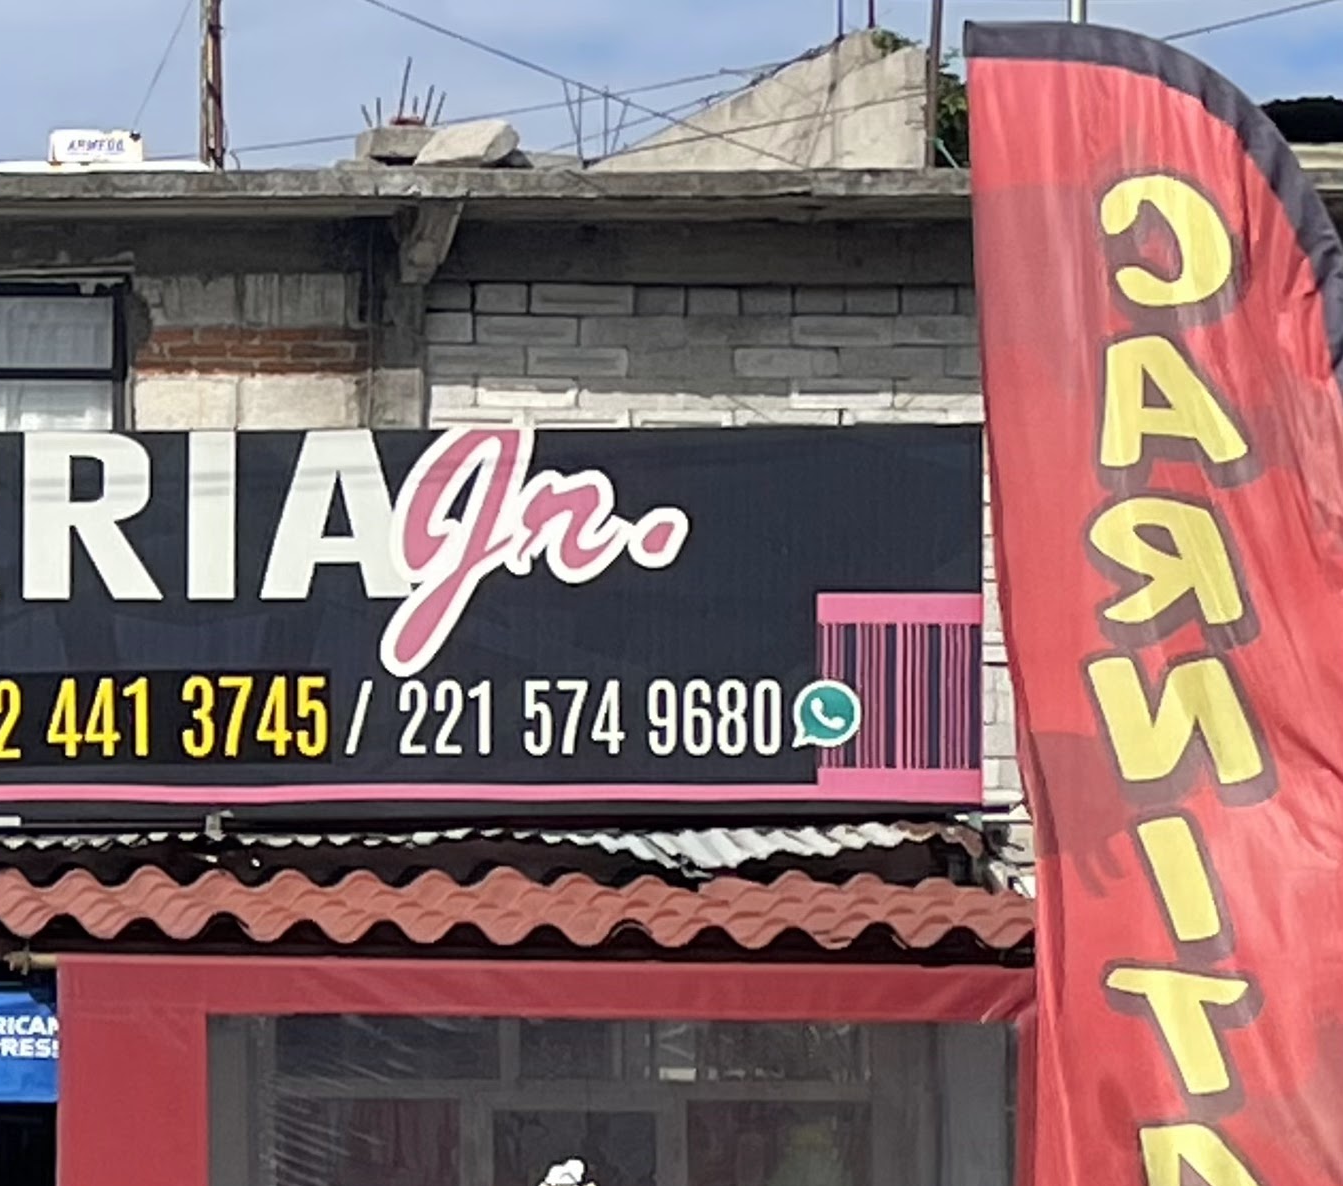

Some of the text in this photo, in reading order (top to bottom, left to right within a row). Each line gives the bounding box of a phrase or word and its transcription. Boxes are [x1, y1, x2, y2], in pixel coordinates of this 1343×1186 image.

[380, 426, 690, 679] Jr.
[46, 677, 150, 758] 441
[180, 675, 328, 759] 3745
[398, 680, 493, 756] 221
[523, 680, 625, 756] 574
[647, 680, 783, 757] 9680
